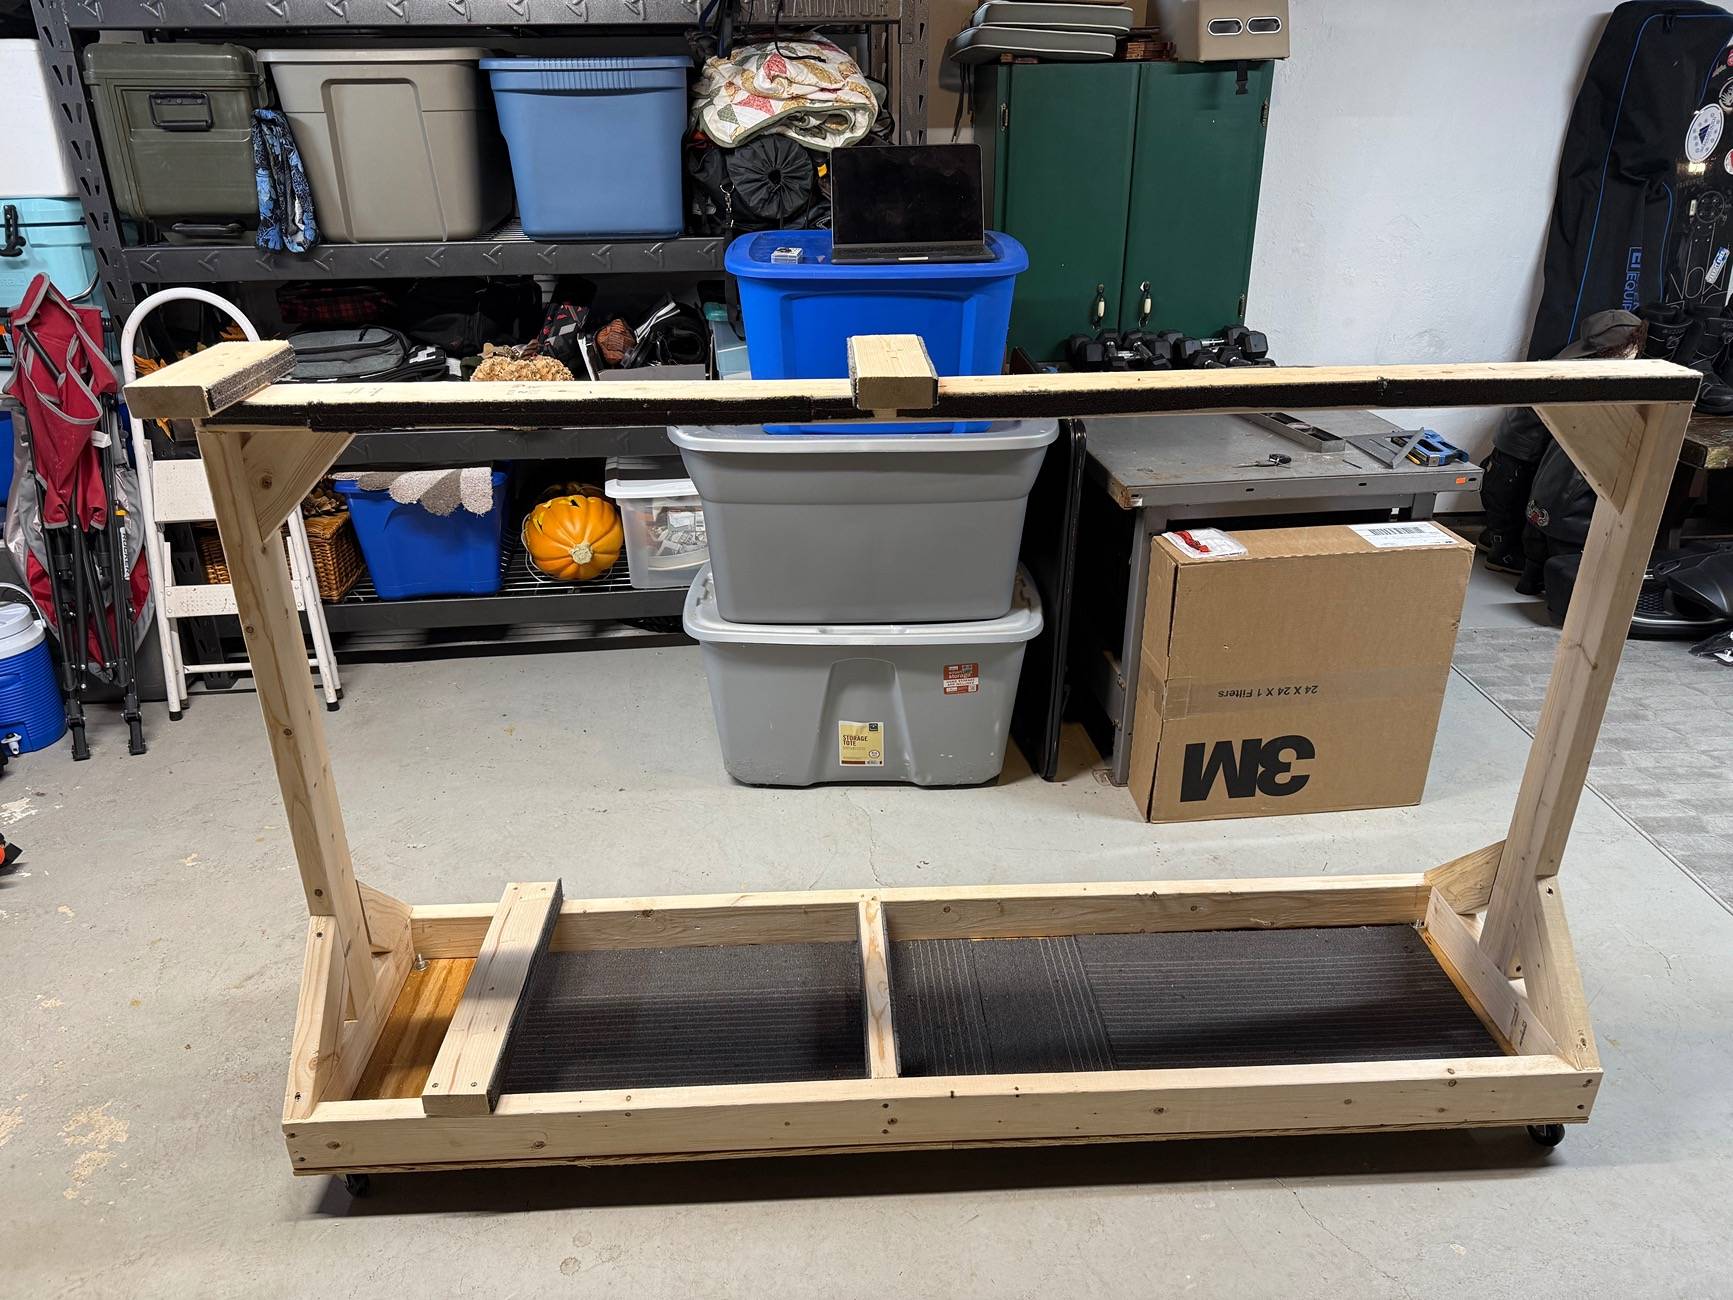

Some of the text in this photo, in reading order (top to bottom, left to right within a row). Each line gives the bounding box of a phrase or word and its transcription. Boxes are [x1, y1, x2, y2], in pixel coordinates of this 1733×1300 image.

[1217, 685, 1319, 698] 24 X 24 X 1 Filters
[1180, 735, 1316, 802] 3M
